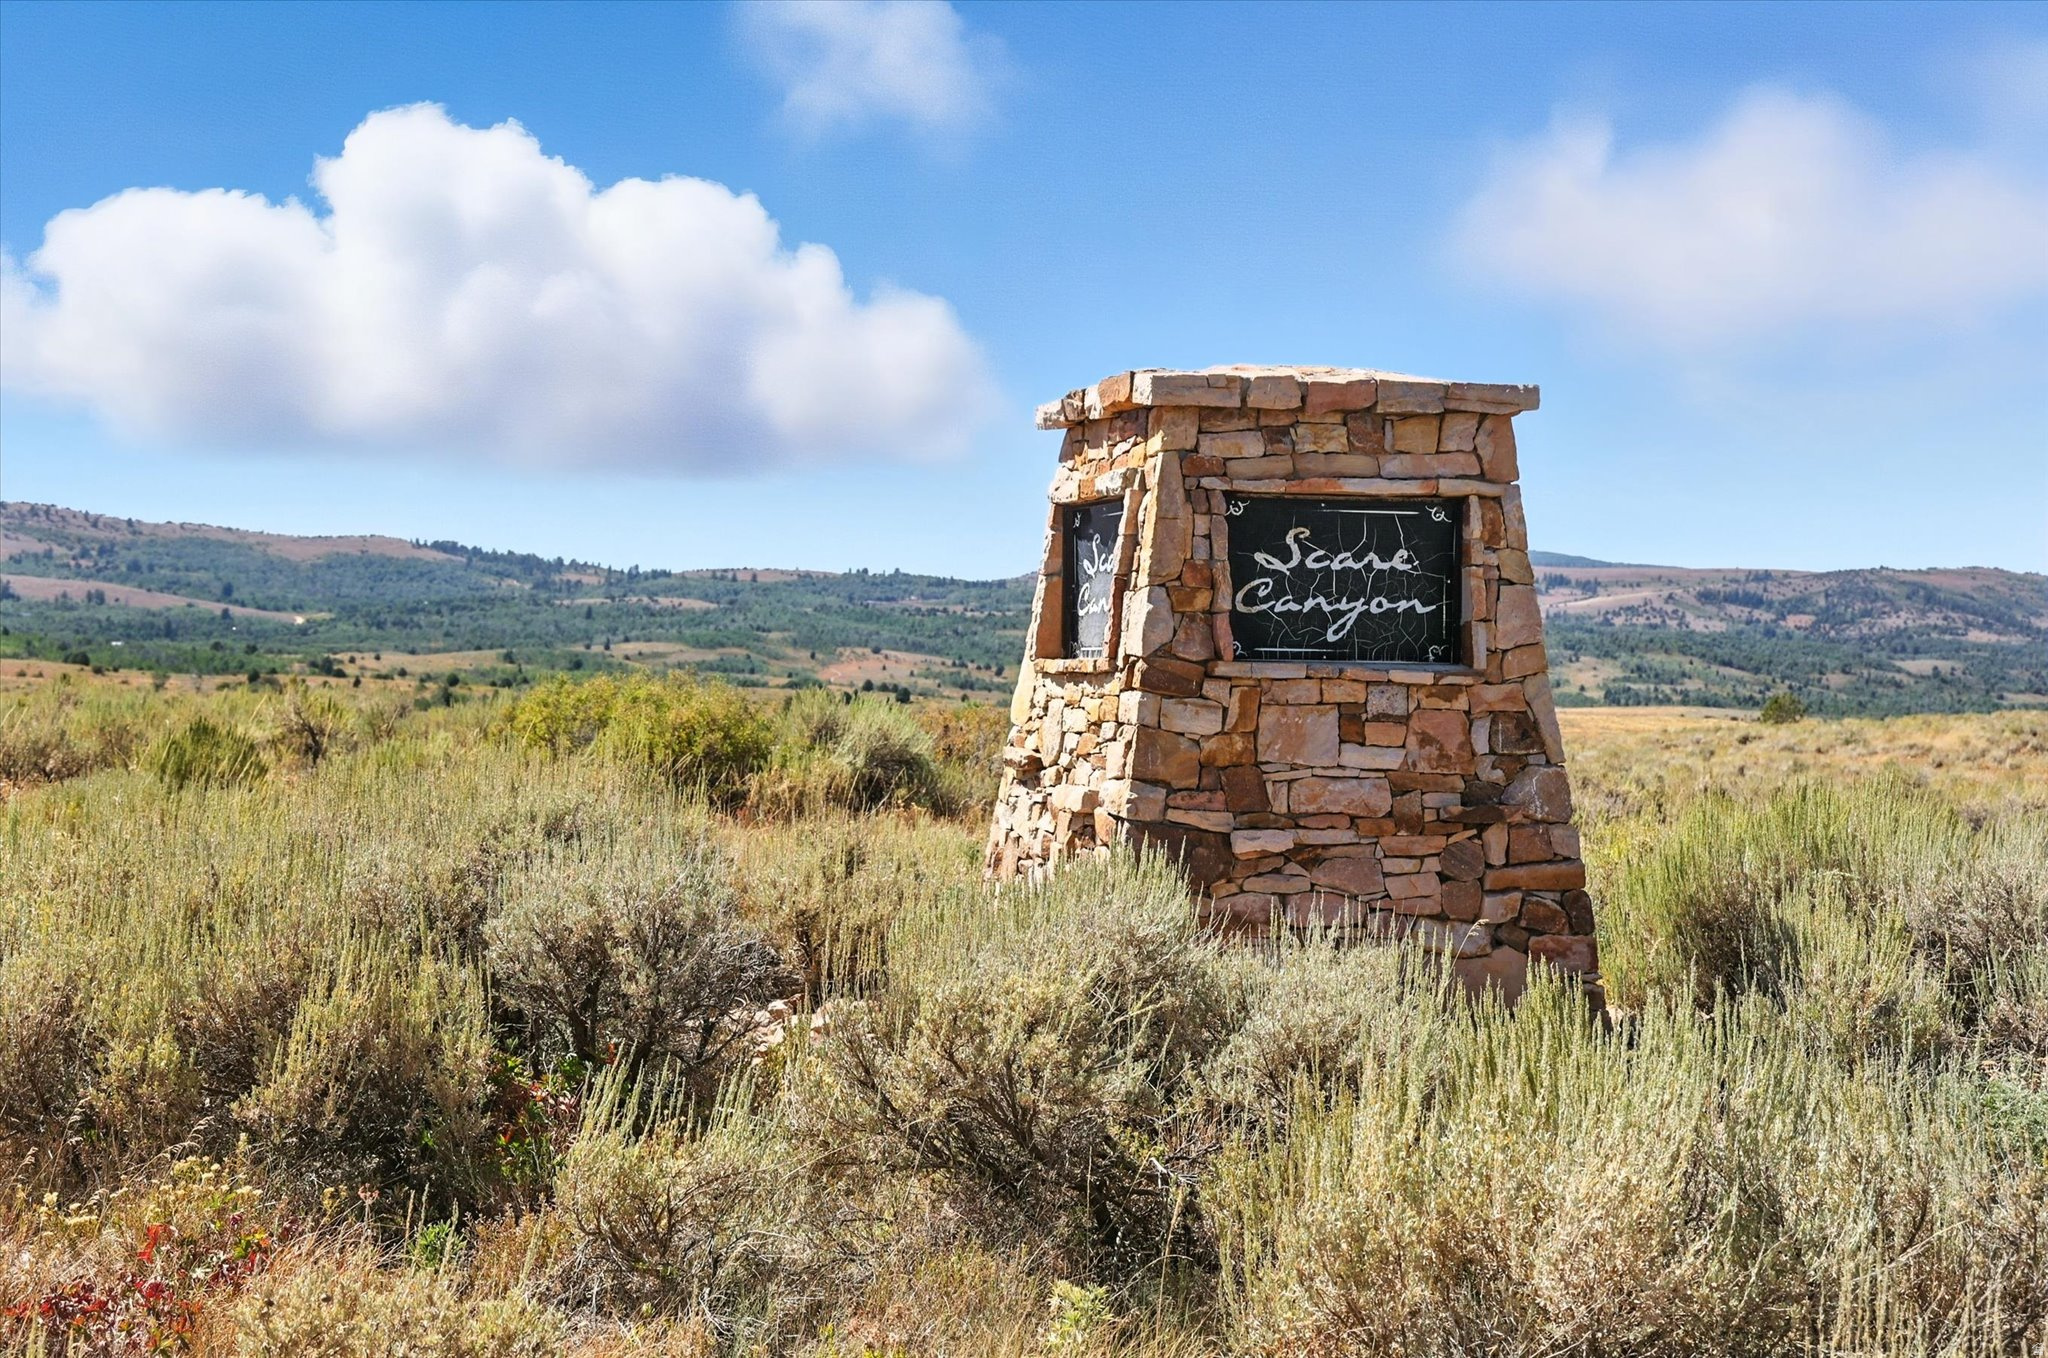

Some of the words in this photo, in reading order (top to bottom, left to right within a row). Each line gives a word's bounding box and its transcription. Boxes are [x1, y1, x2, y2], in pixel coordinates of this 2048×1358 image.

[1083, 533, 1115, 577] Sca
[1253, 527, 1419, 575] Scare
[1077, 582, 1110, 617] Can
[1235, 577, 1437, 642] Canyon
